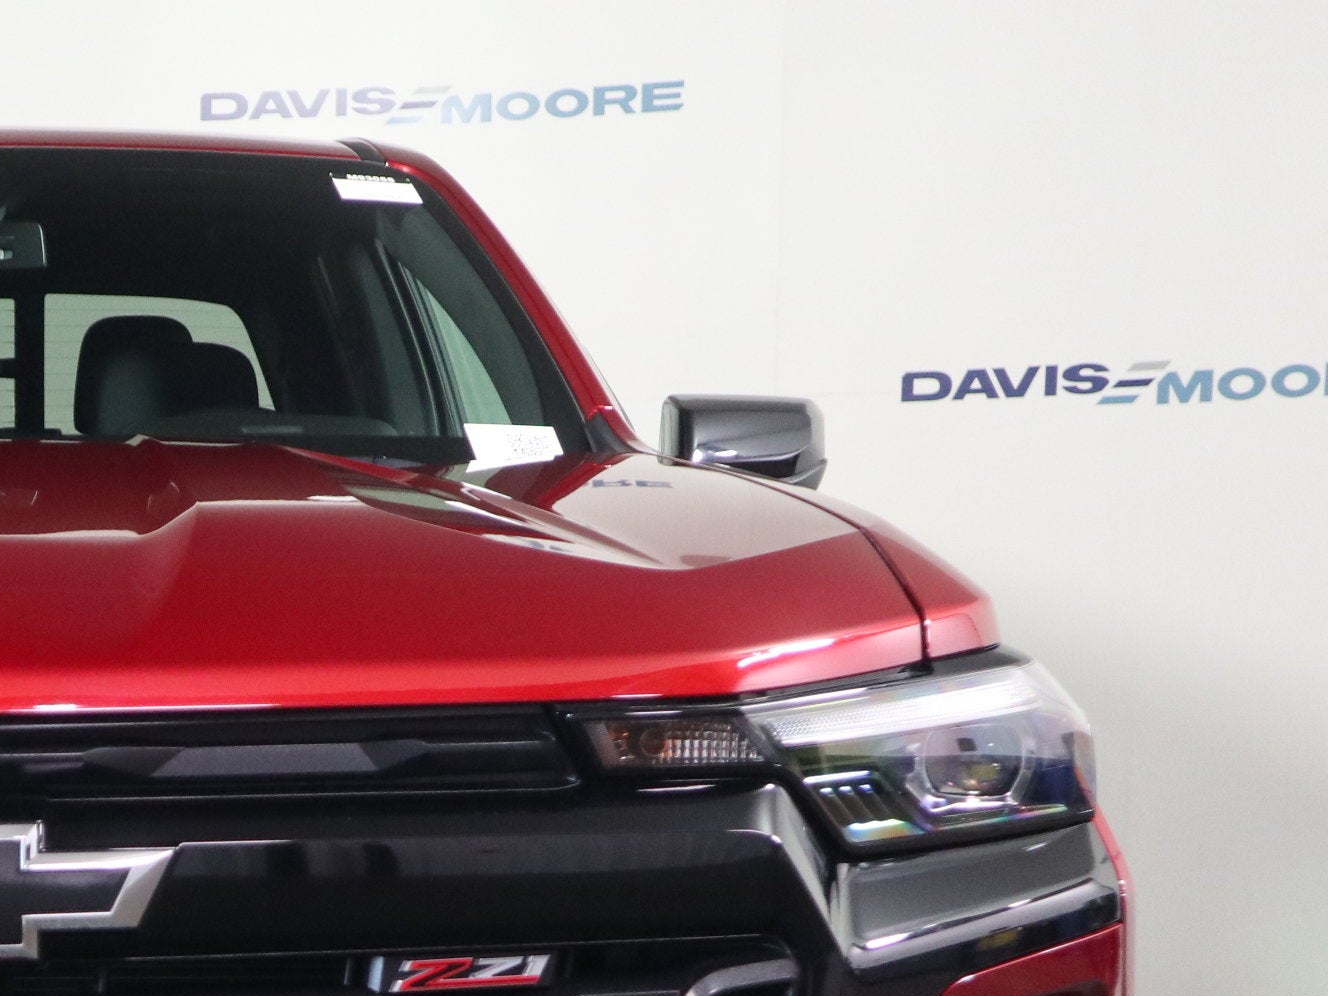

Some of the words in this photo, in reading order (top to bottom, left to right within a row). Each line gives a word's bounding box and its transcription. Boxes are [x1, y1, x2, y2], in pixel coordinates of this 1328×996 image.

[199, 85, 395, 122] DAVIS
[440, 79, 685, 124] MOORE
[900, 362, 1110, 402] DAVIS
[1156, 363, 1328, 405] MOO
